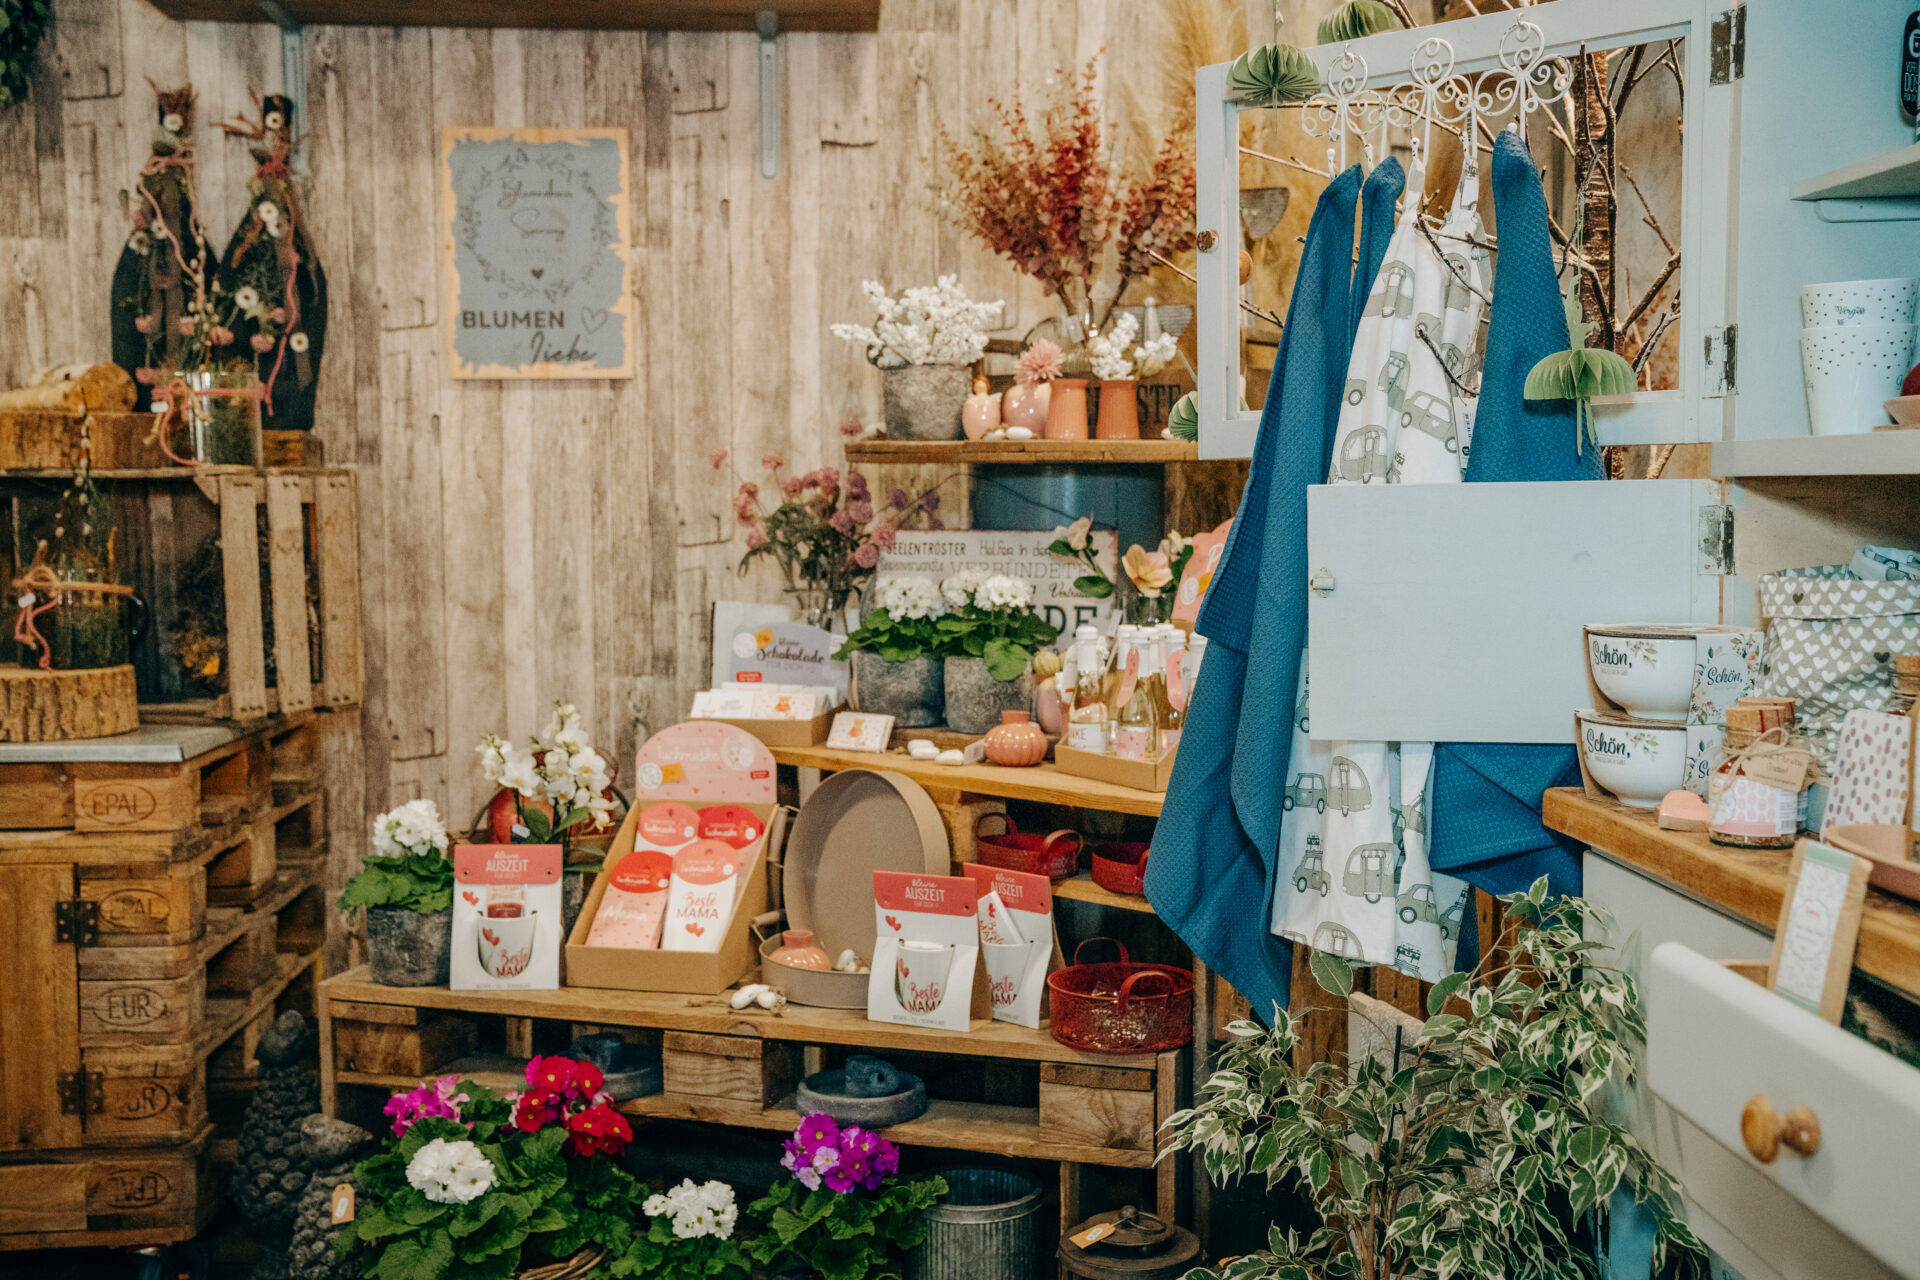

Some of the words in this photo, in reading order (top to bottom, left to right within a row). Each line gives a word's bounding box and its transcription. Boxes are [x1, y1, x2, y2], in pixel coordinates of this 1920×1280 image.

[462, 310, 565, 329] BLUMEN
[756, 646, 825, 663] Schokolade
[1592, 640, 1633, 668] Schön,
[1707, 666, 1743, 686] Schön,
[1586, 728, 1631, 759] Schön,
[92, 793, 145, 816] EPAL
[486, 859, 529, 872] AUSZEIT
[905, 887, 945, 902] AUSZEIT
[990, 881, 1024, 898] AUSZEIT
[685, 890, 717, 908] Beste
[676, 906, 719, 919] MAMA
[496, 966, 525, 977] MAM
[909, 981, 940, 1001] Beste
[107, 993, 150, 1019] EUR
